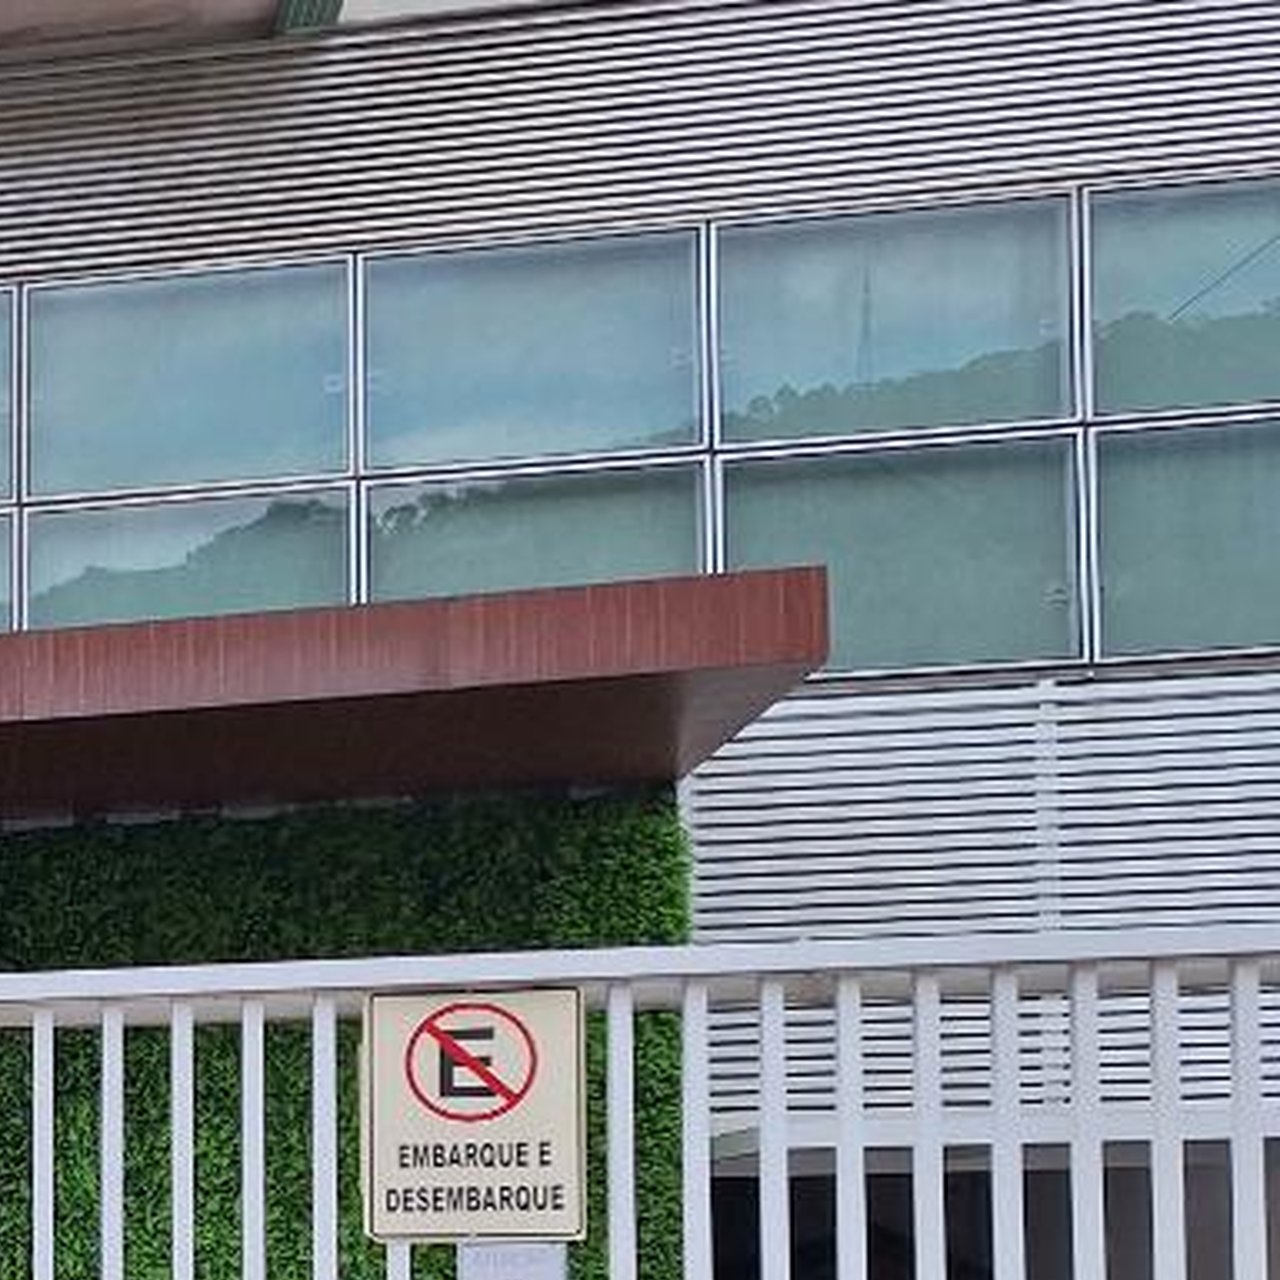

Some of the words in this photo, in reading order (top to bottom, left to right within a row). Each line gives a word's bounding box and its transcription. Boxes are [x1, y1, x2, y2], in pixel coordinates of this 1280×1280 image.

[397, 1142, 530, 1170] EMBARQUE
[538, 1141, 552, 1167] E
[385, 1185, 566, 1213] DESEMBARQUE
